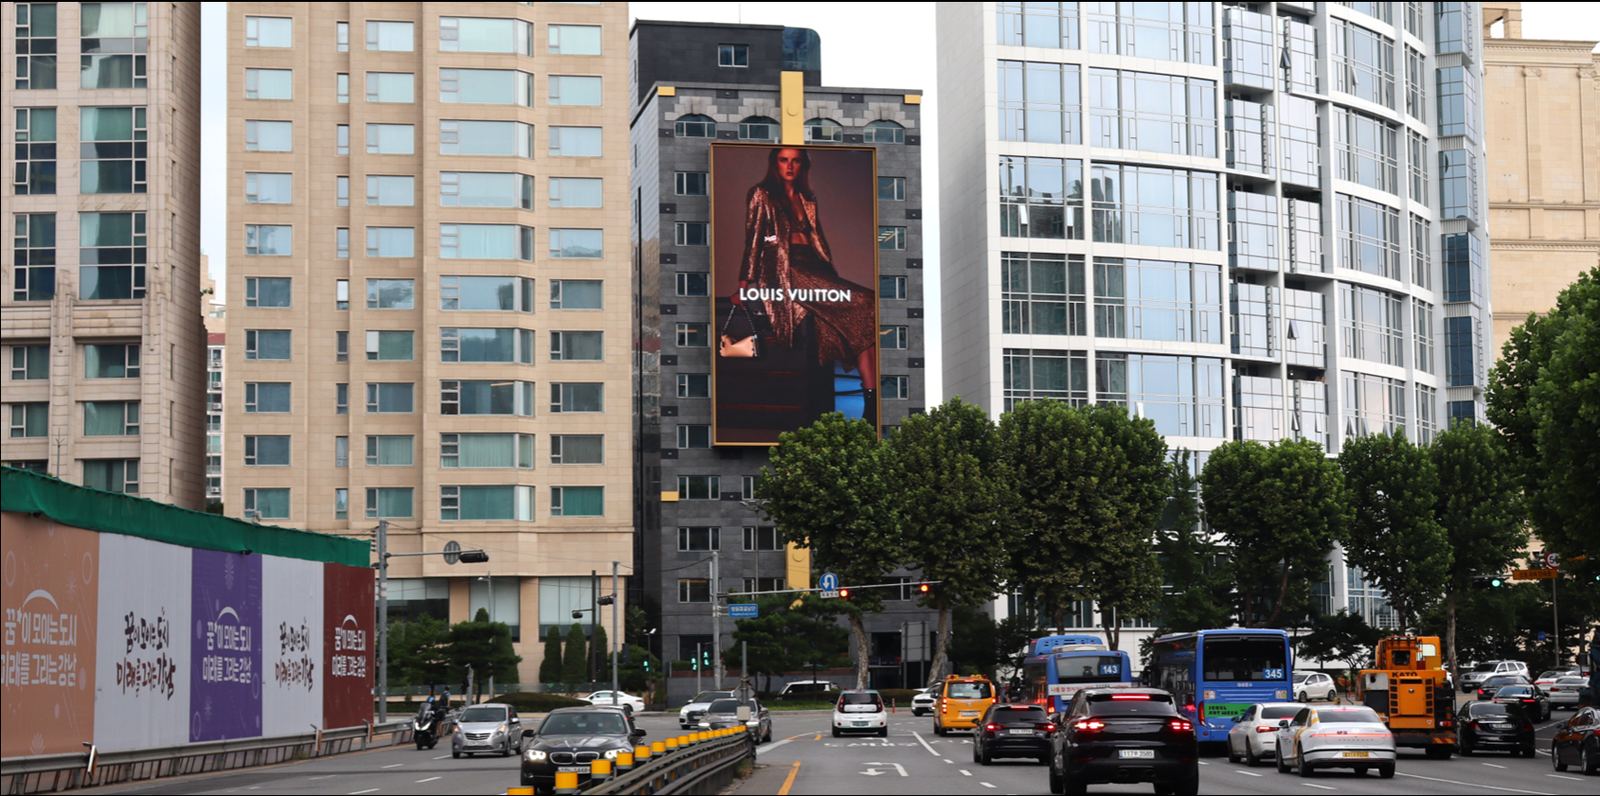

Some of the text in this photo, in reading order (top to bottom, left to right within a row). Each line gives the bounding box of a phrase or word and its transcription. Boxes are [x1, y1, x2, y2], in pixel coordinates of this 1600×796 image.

[740, 287, 852, 302] LOUIS VUITTON
[5, 608, 77, 646] 꿈이 모이는 도시
[125, 611, 140, 654] 꿈이
[140, 617, 156, 650] 모이는
[207, 621, 251, 651] 꿈이 모이는 도시
[1, 651, 77, 687] 미래를 그리는 강남
[156, 652, 176, 701] 강남
[203, 655, 252, 684] 미래를 그리는 강남
[1103, 665, 1118, 674] 143
[1265, 669, 1282, 679] 345
